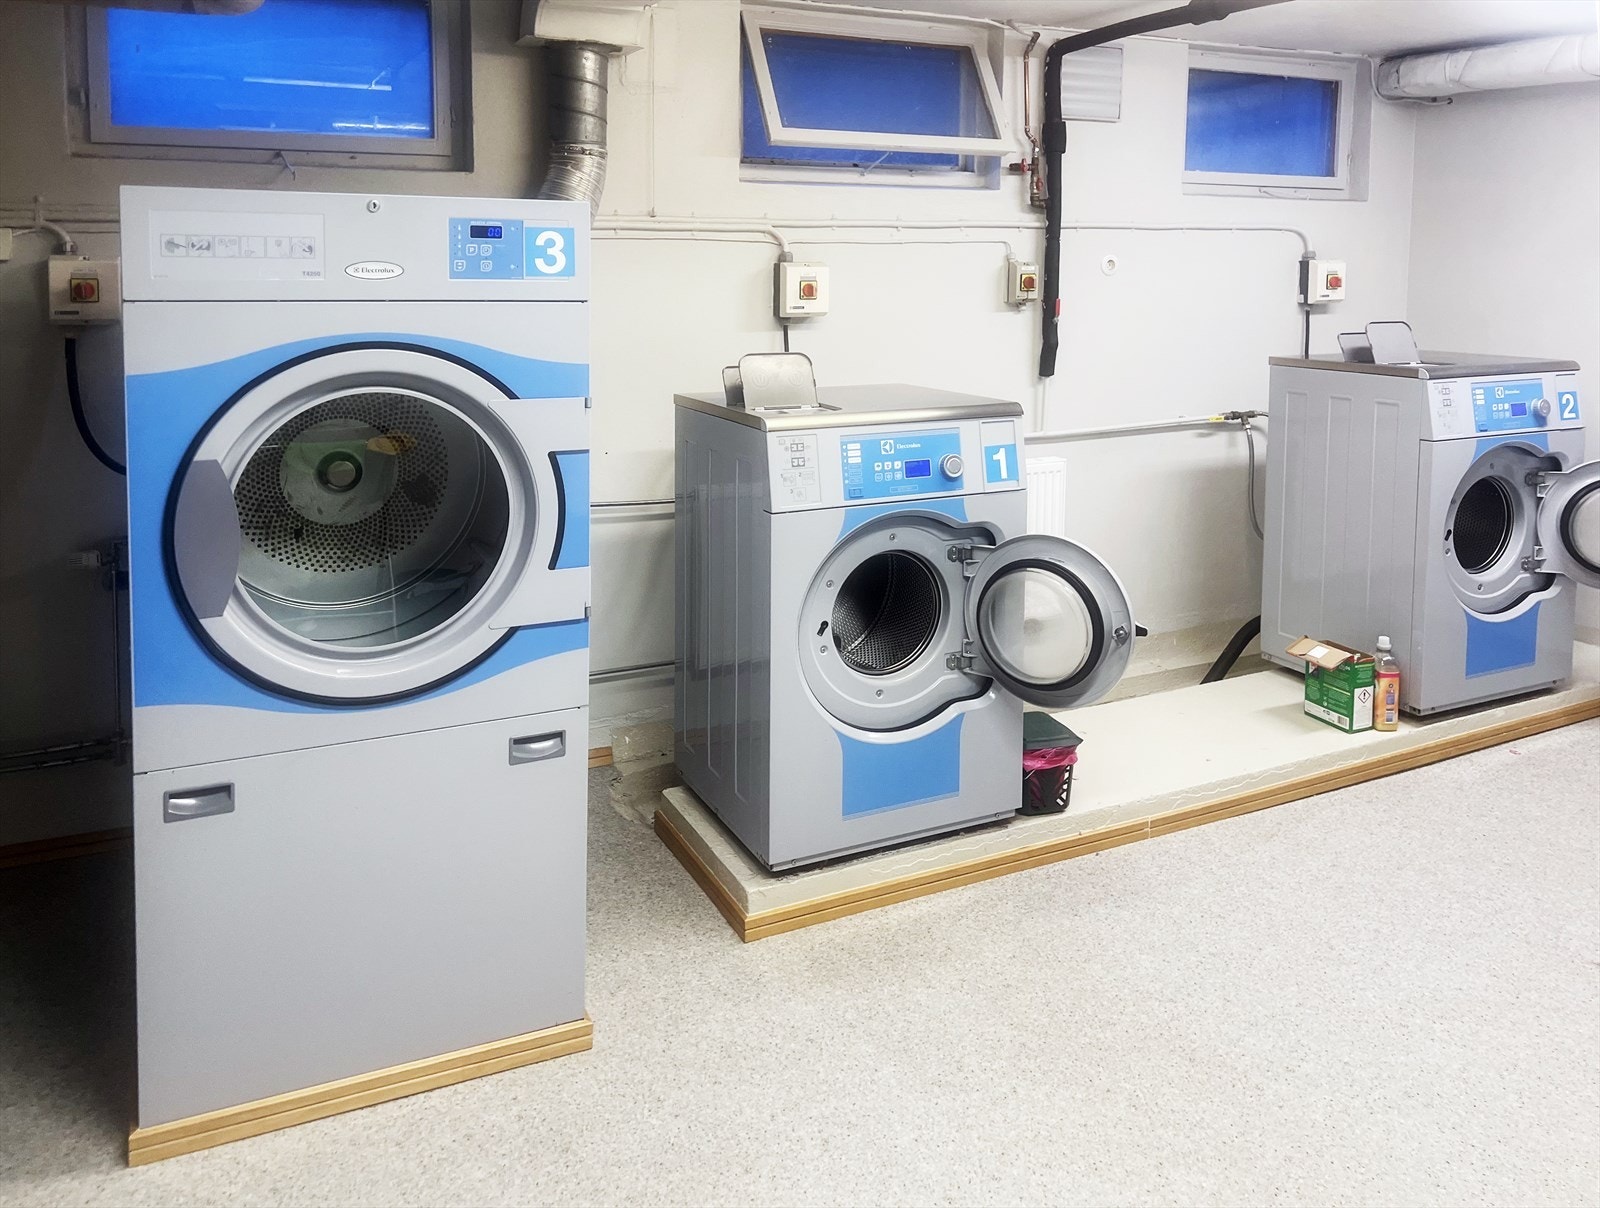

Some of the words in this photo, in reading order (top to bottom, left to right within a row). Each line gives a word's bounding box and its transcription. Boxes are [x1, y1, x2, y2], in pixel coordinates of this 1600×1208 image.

[487, 227, 501, 237] 00
[534, 230, 567, 274] 3
[1561, 393, 1577, 419] 2
[896, 442, 921, 450] Electrolux
[992, 447, 1008, 479] 1
